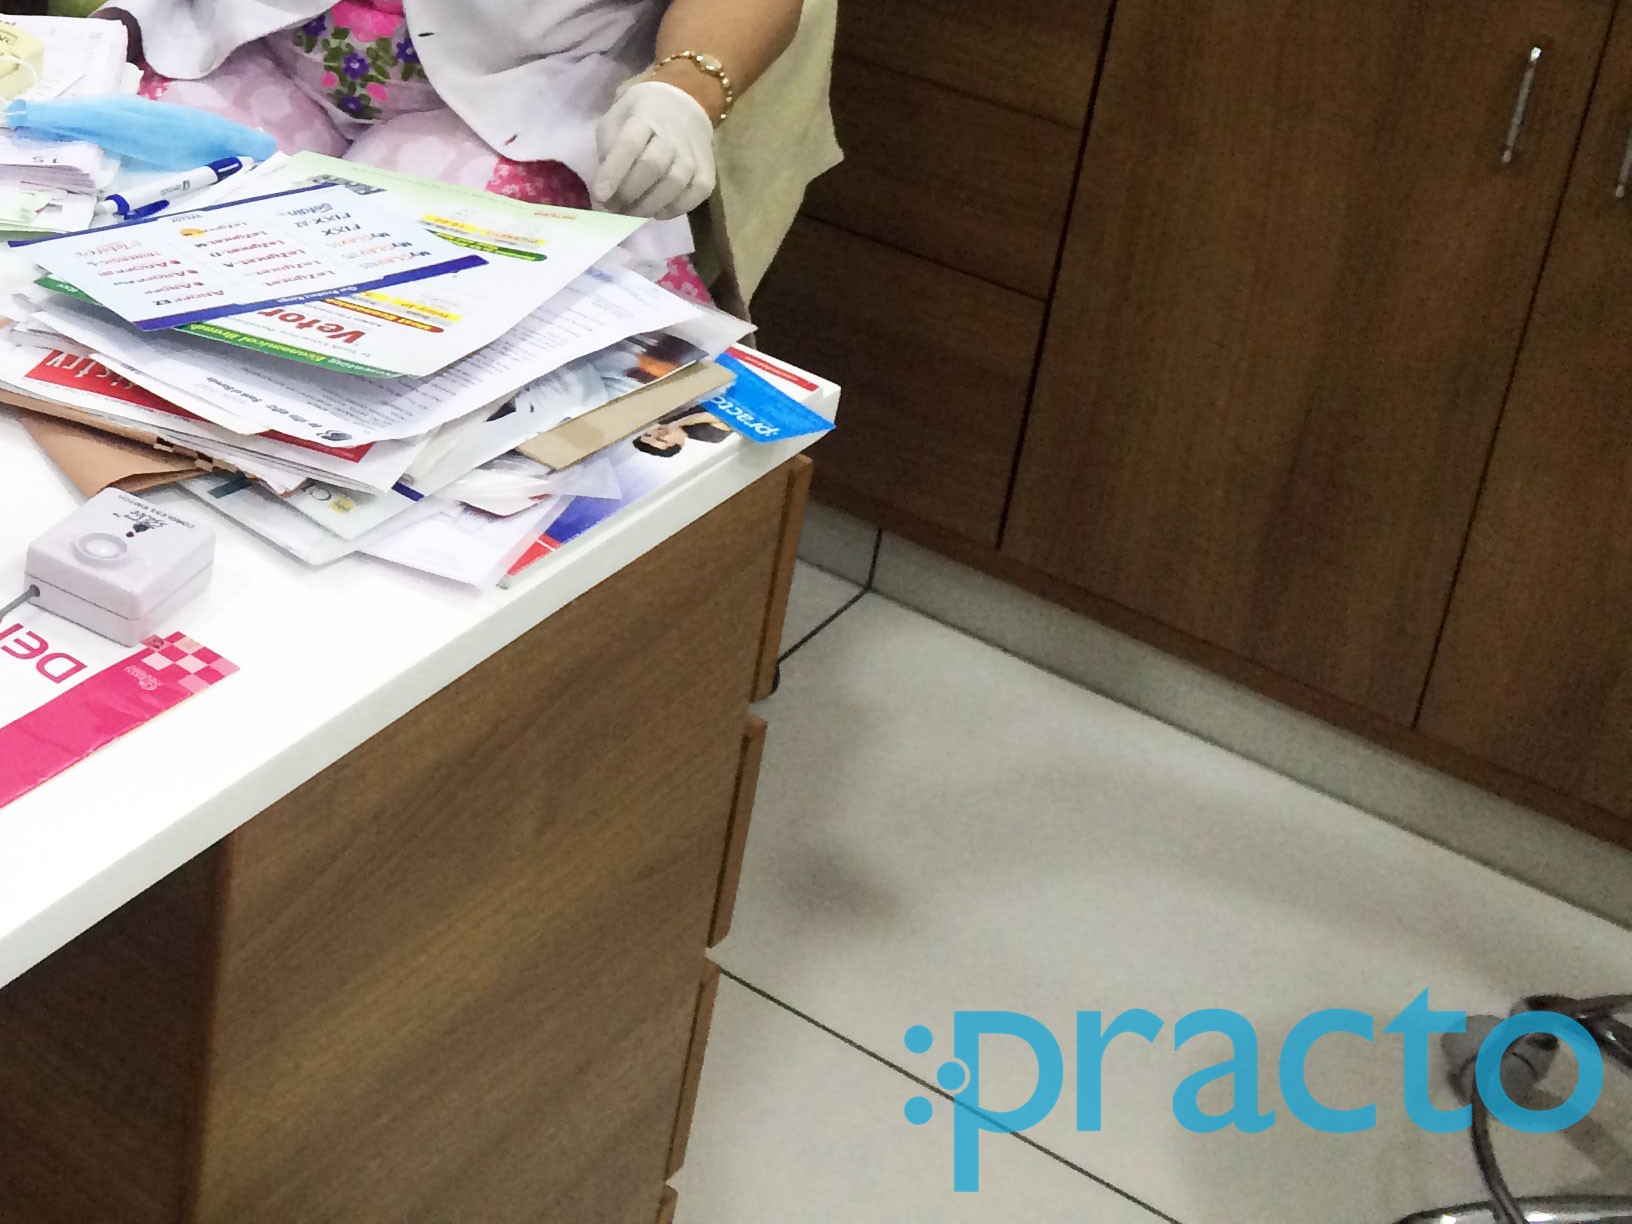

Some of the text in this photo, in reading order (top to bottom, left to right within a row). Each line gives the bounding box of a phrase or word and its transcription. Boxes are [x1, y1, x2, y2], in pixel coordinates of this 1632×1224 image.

[32, 155, 59, 166] 15
[320, 222, 362, 237] FIXX
[150, 506, 195, 529] CORDLESS
